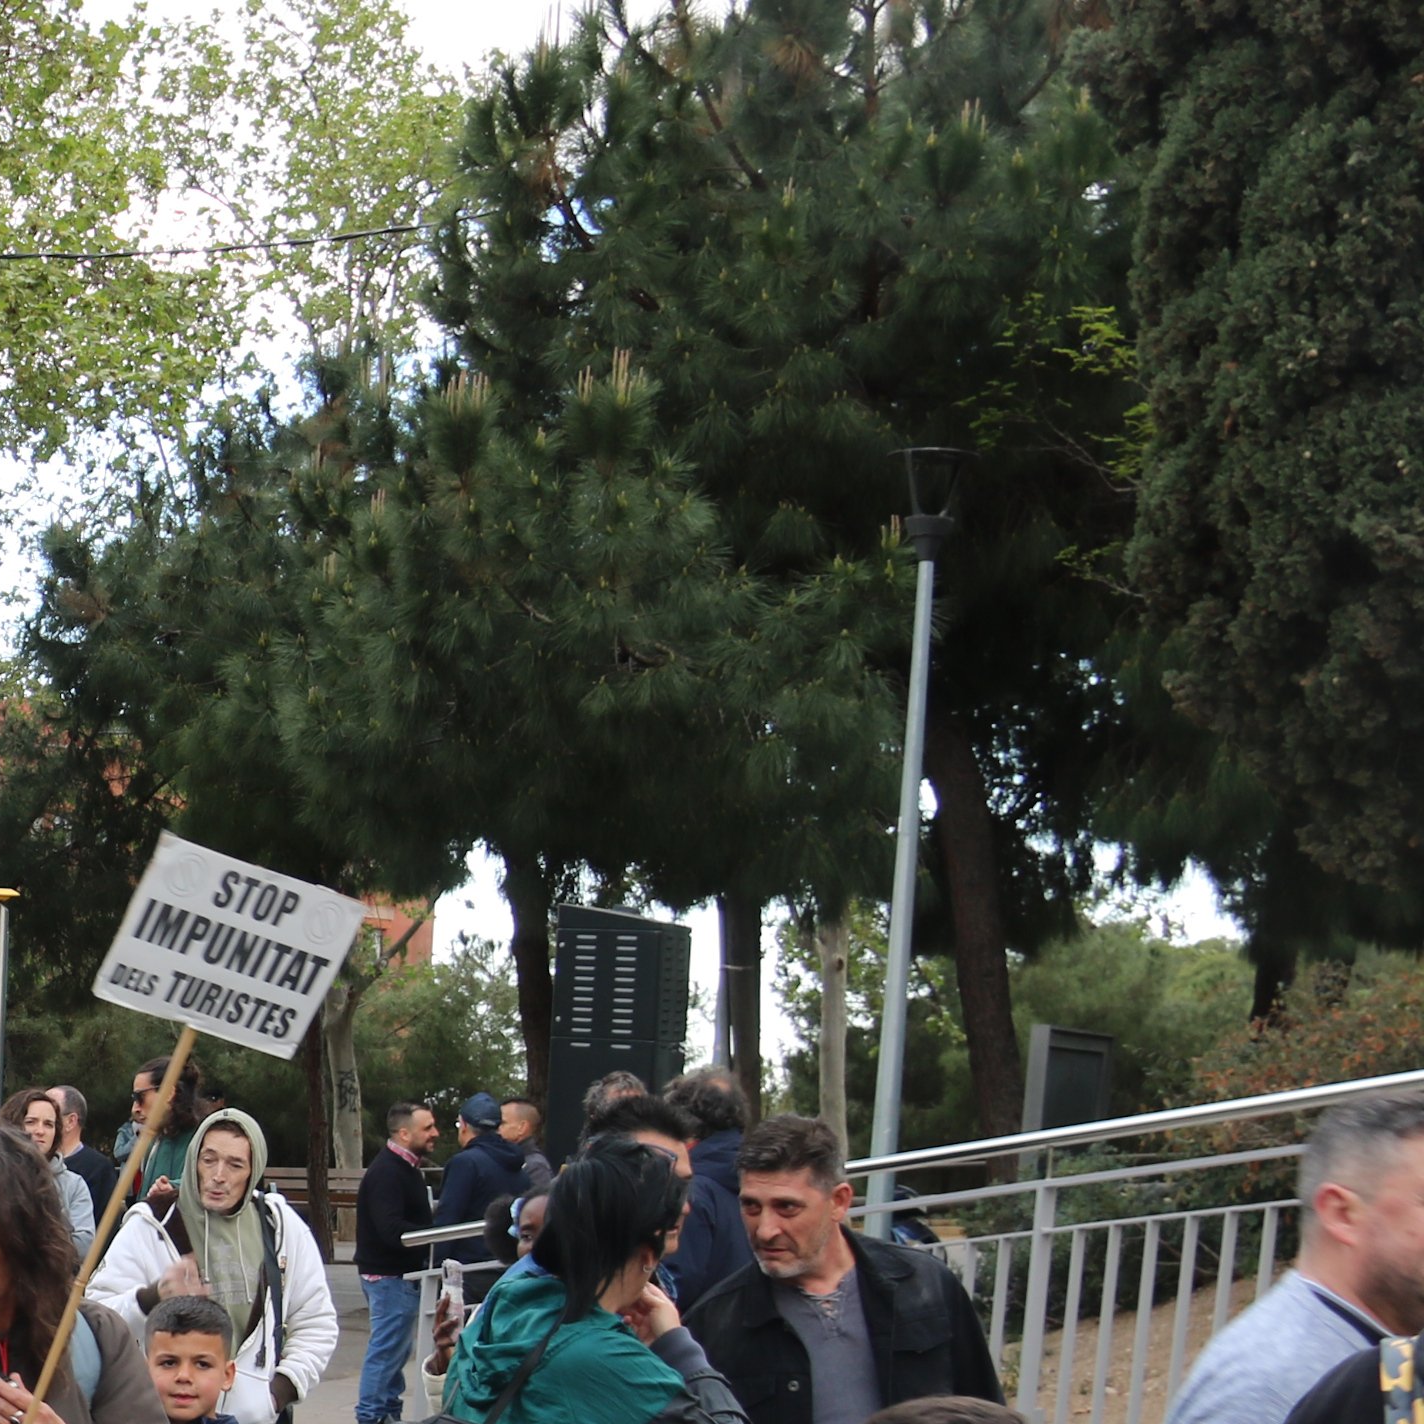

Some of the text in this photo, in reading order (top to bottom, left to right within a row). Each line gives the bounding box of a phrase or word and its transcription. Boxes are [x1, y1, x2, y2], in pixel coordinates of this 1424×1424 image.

[213, 871, 300, 927] STOP
[132, 898, 330, 995] IMPUNITAT
[109, 962, 296, 1039] DELS TURISTES
